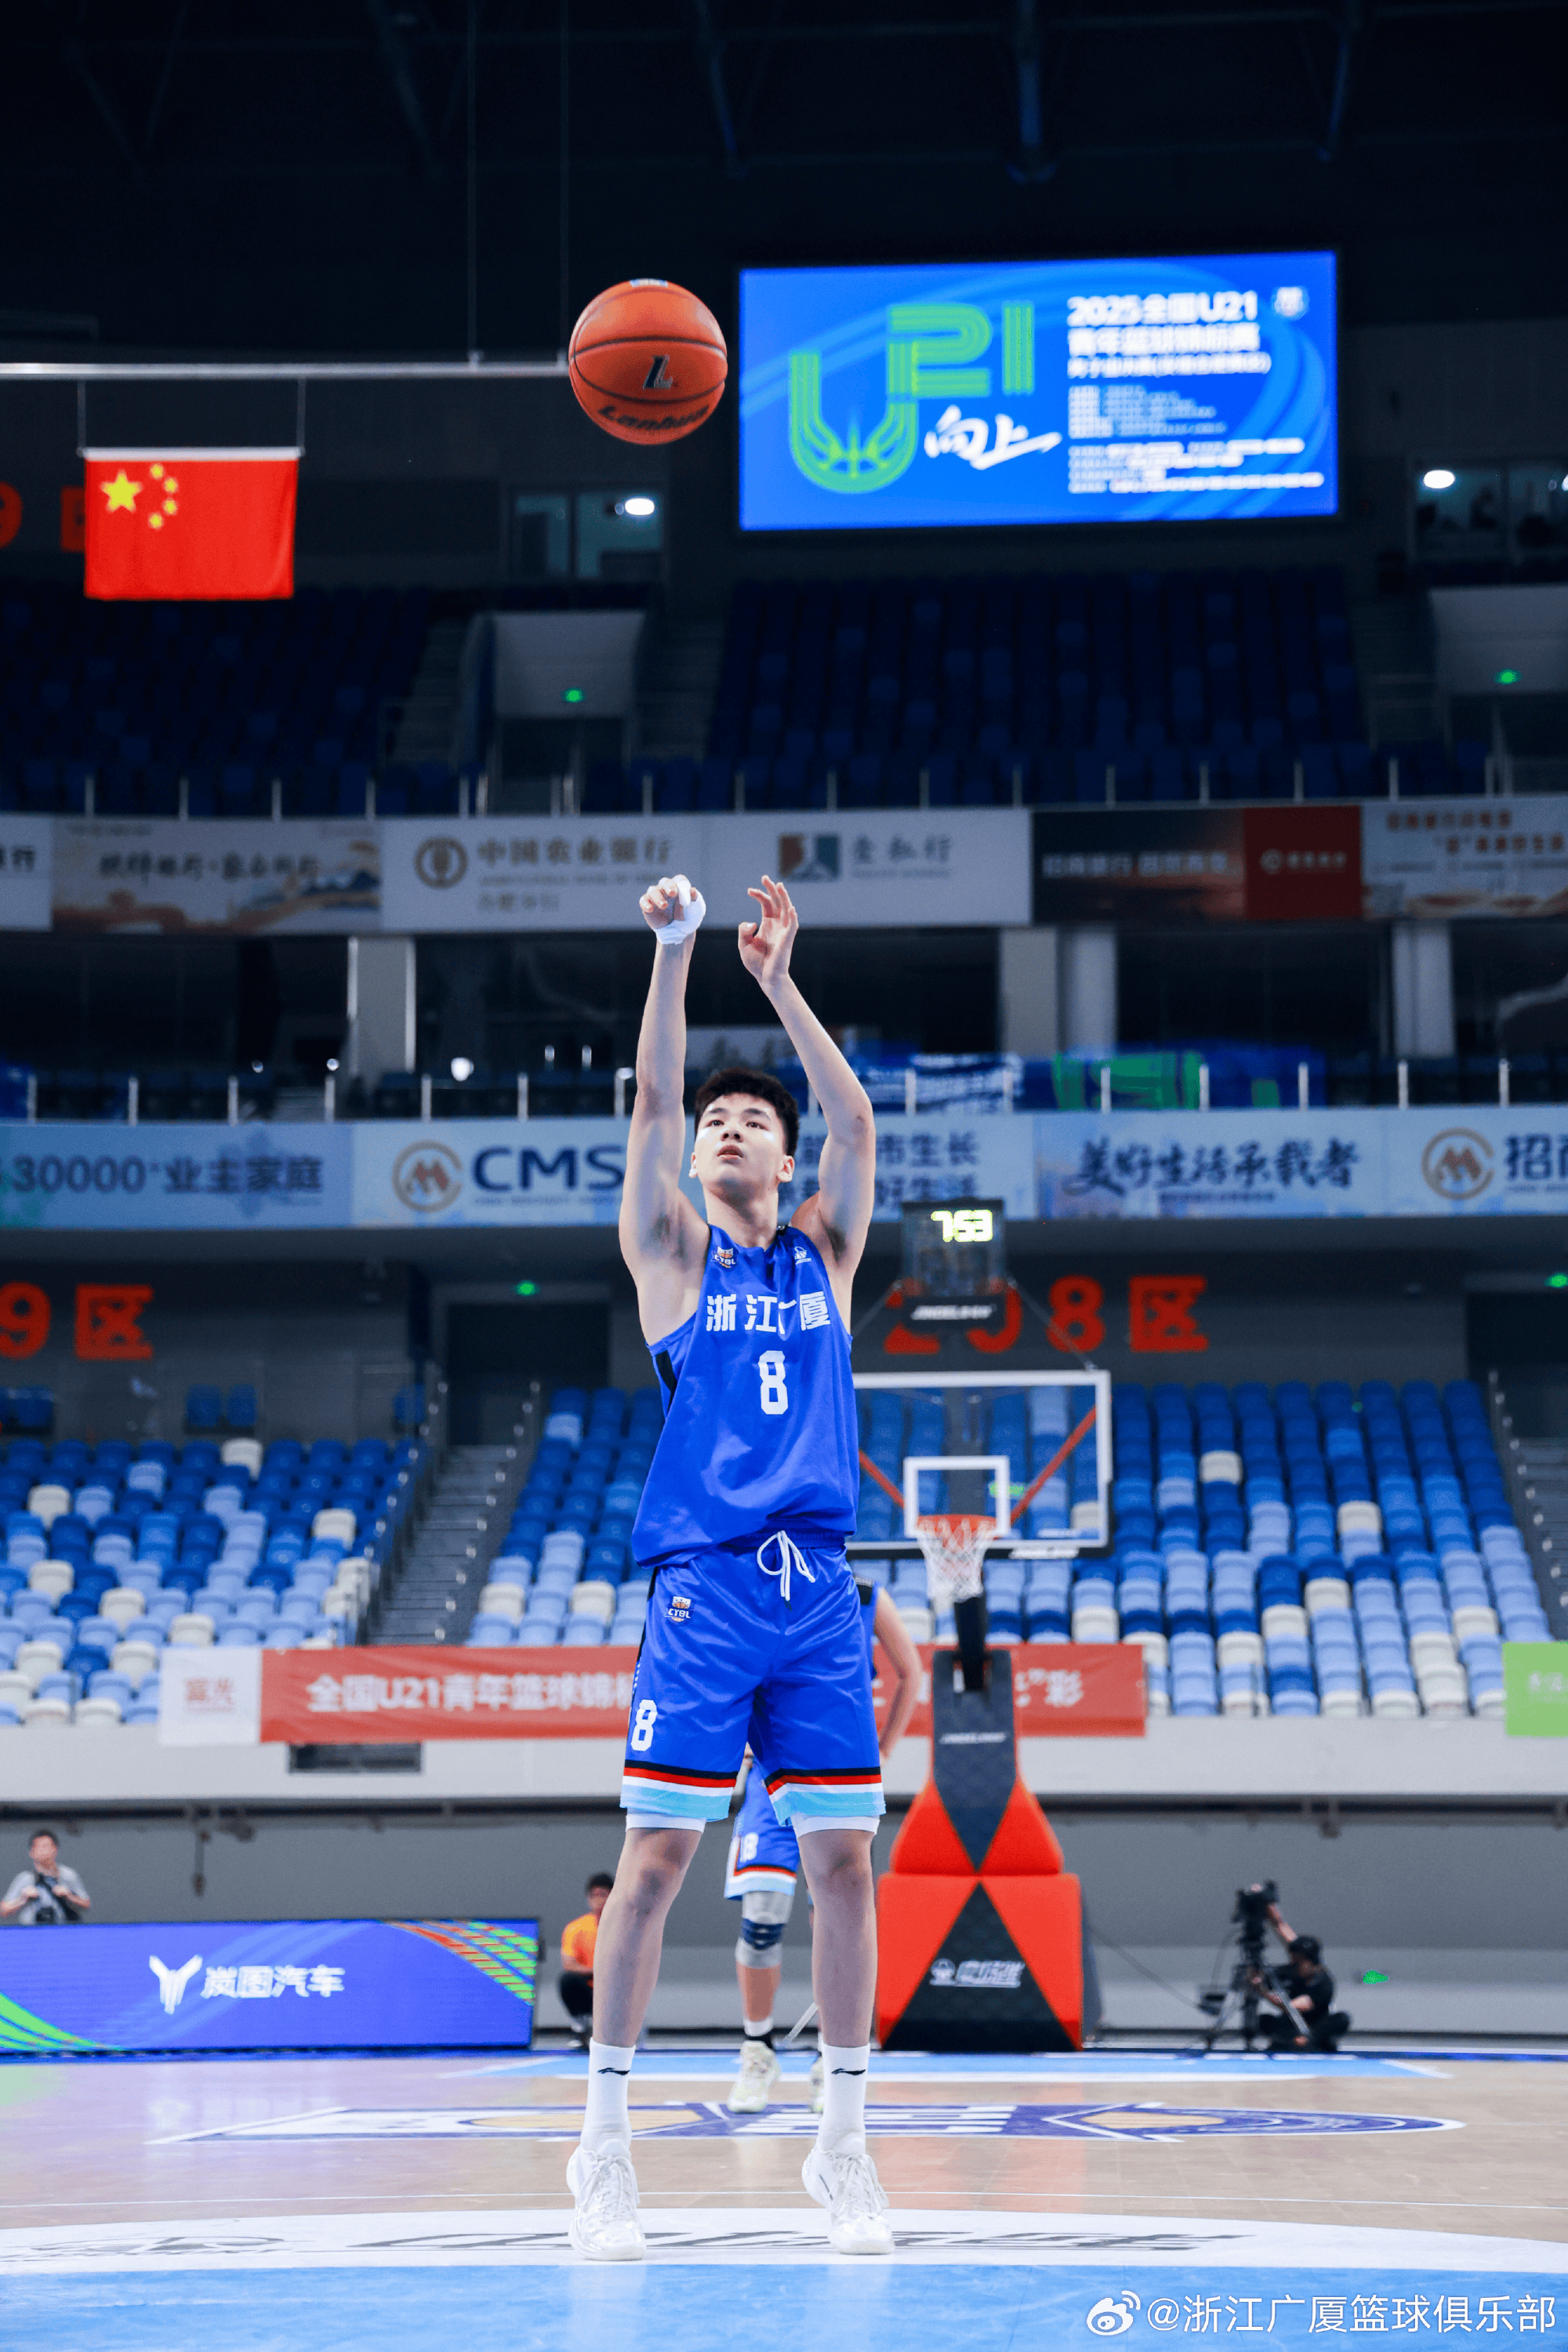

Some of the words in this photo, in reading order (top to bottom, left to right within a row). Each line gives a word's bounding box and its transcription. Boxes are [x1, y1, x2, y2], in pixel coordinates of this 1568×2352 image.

[924, 405, 1061, 470] 向上
[706, 1290, 831, 1335] 浙江广厦
[758, 1350, 789, 1415] 8
[667, 1608, 691, 1619] CYBL
[630, 1699, 658, 1751] 8
[200, 1964, 346, 1999] 岚图汽车
